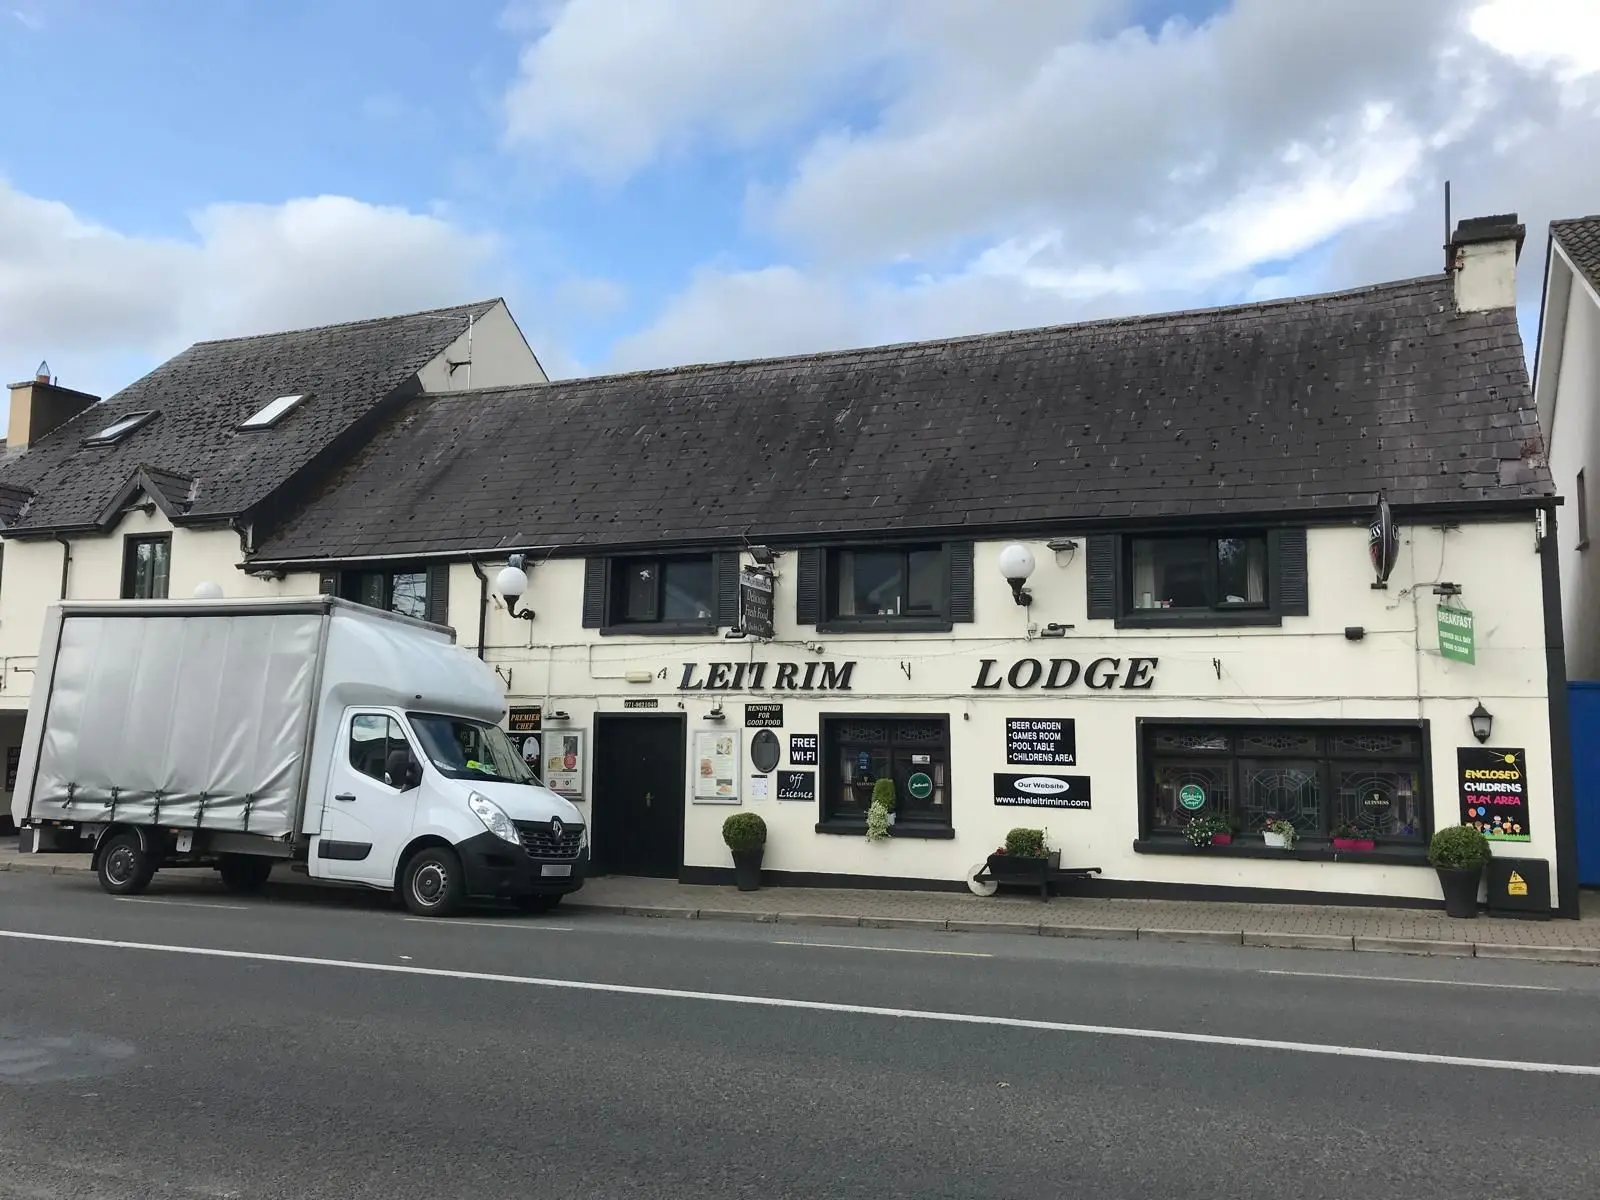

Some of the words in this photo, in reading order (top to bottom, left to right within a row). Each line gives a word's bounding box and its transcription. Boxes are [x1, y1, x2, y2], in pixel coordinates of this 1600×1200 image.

[757, 608, 768, 620] Food
[1439, 611, 1471, 628] BREAKFAST
[677, 661, 857, 690] LEITRIM
[971, 657, 1158, 690] LODGE
[747, 704, 781, 712] RENOWNED
[510, 713, 541, 721] PREMIER
[516, 722, 534, 730] CHEF
[1012, 721, 1030, 730] BEER
[1032, 722, 1061, 730] GARDEN
[1012, 732, 1037, 740] GAMES
[1039, 732, 1061, 740] ROOM
[791, 738, 816, 748] FREE
[1012, 742, 1031, 750] POOL
[1033, 742, 1055, 751] TABLE
[792, 751, 816, 761] WI-FI
[1013, 753, 1053, 762] CHILDRENS
[1054, 754, 1074, 762] AREA
[1465, 769, 1519, 780] ENCLOSED
[1464, 782, 1522, 793] CHILDRENS
[778, 788, 814, 799] Licence
[995, 796, 1090, 807] www.theleitriminn.com
[1466, 795, 1492, 804] PLAY
[1494, 796, 1521, 805] AREA
